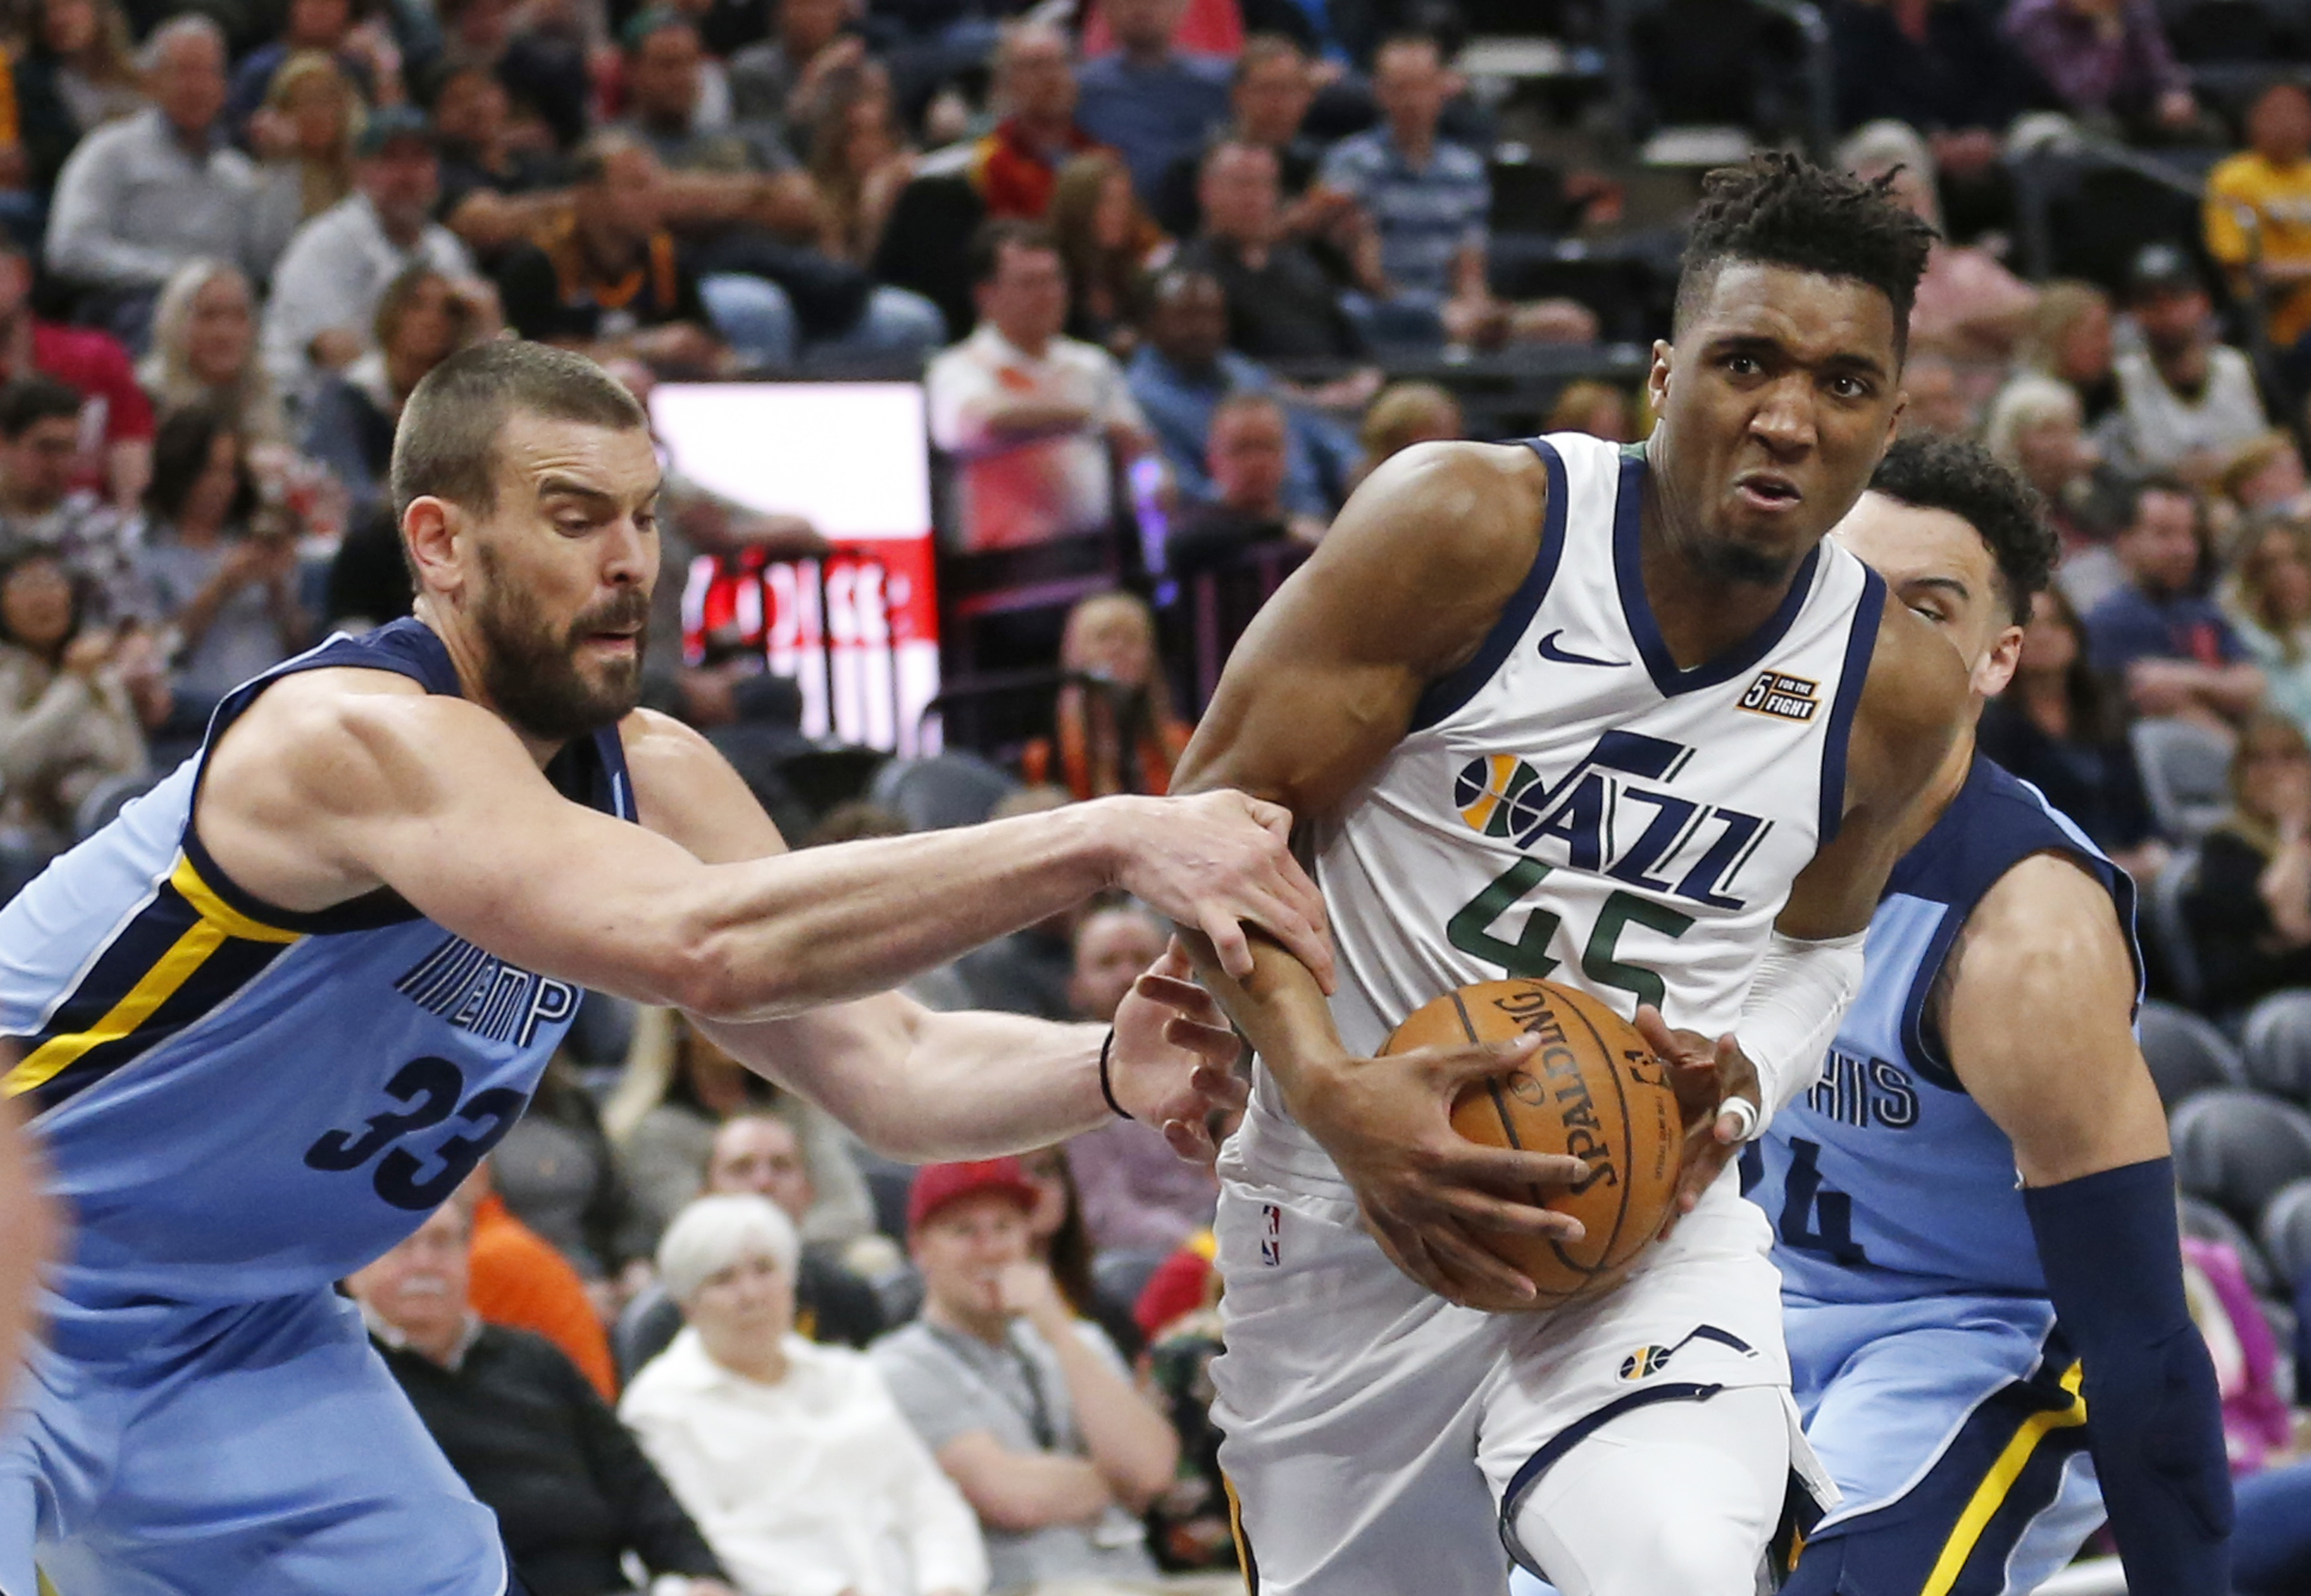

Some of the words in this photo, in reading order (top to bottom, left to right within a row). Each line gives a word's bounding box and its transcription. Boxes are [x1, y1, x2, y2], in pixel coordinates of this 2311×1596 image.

[1744, 675, 1773, 706] 5
[1765, 695, 1813, 717] FIGHT
[1778, 679, 1795, 690] FOR
[1795, 682, 1812, 694] THE
[1455, 730, 1776, 910] JAZZ
[1447, 856, 1696, 1025] 45
[304, 1056, 529, 1210] 33
[1494, 991, 1617, 1196] SPALDING
